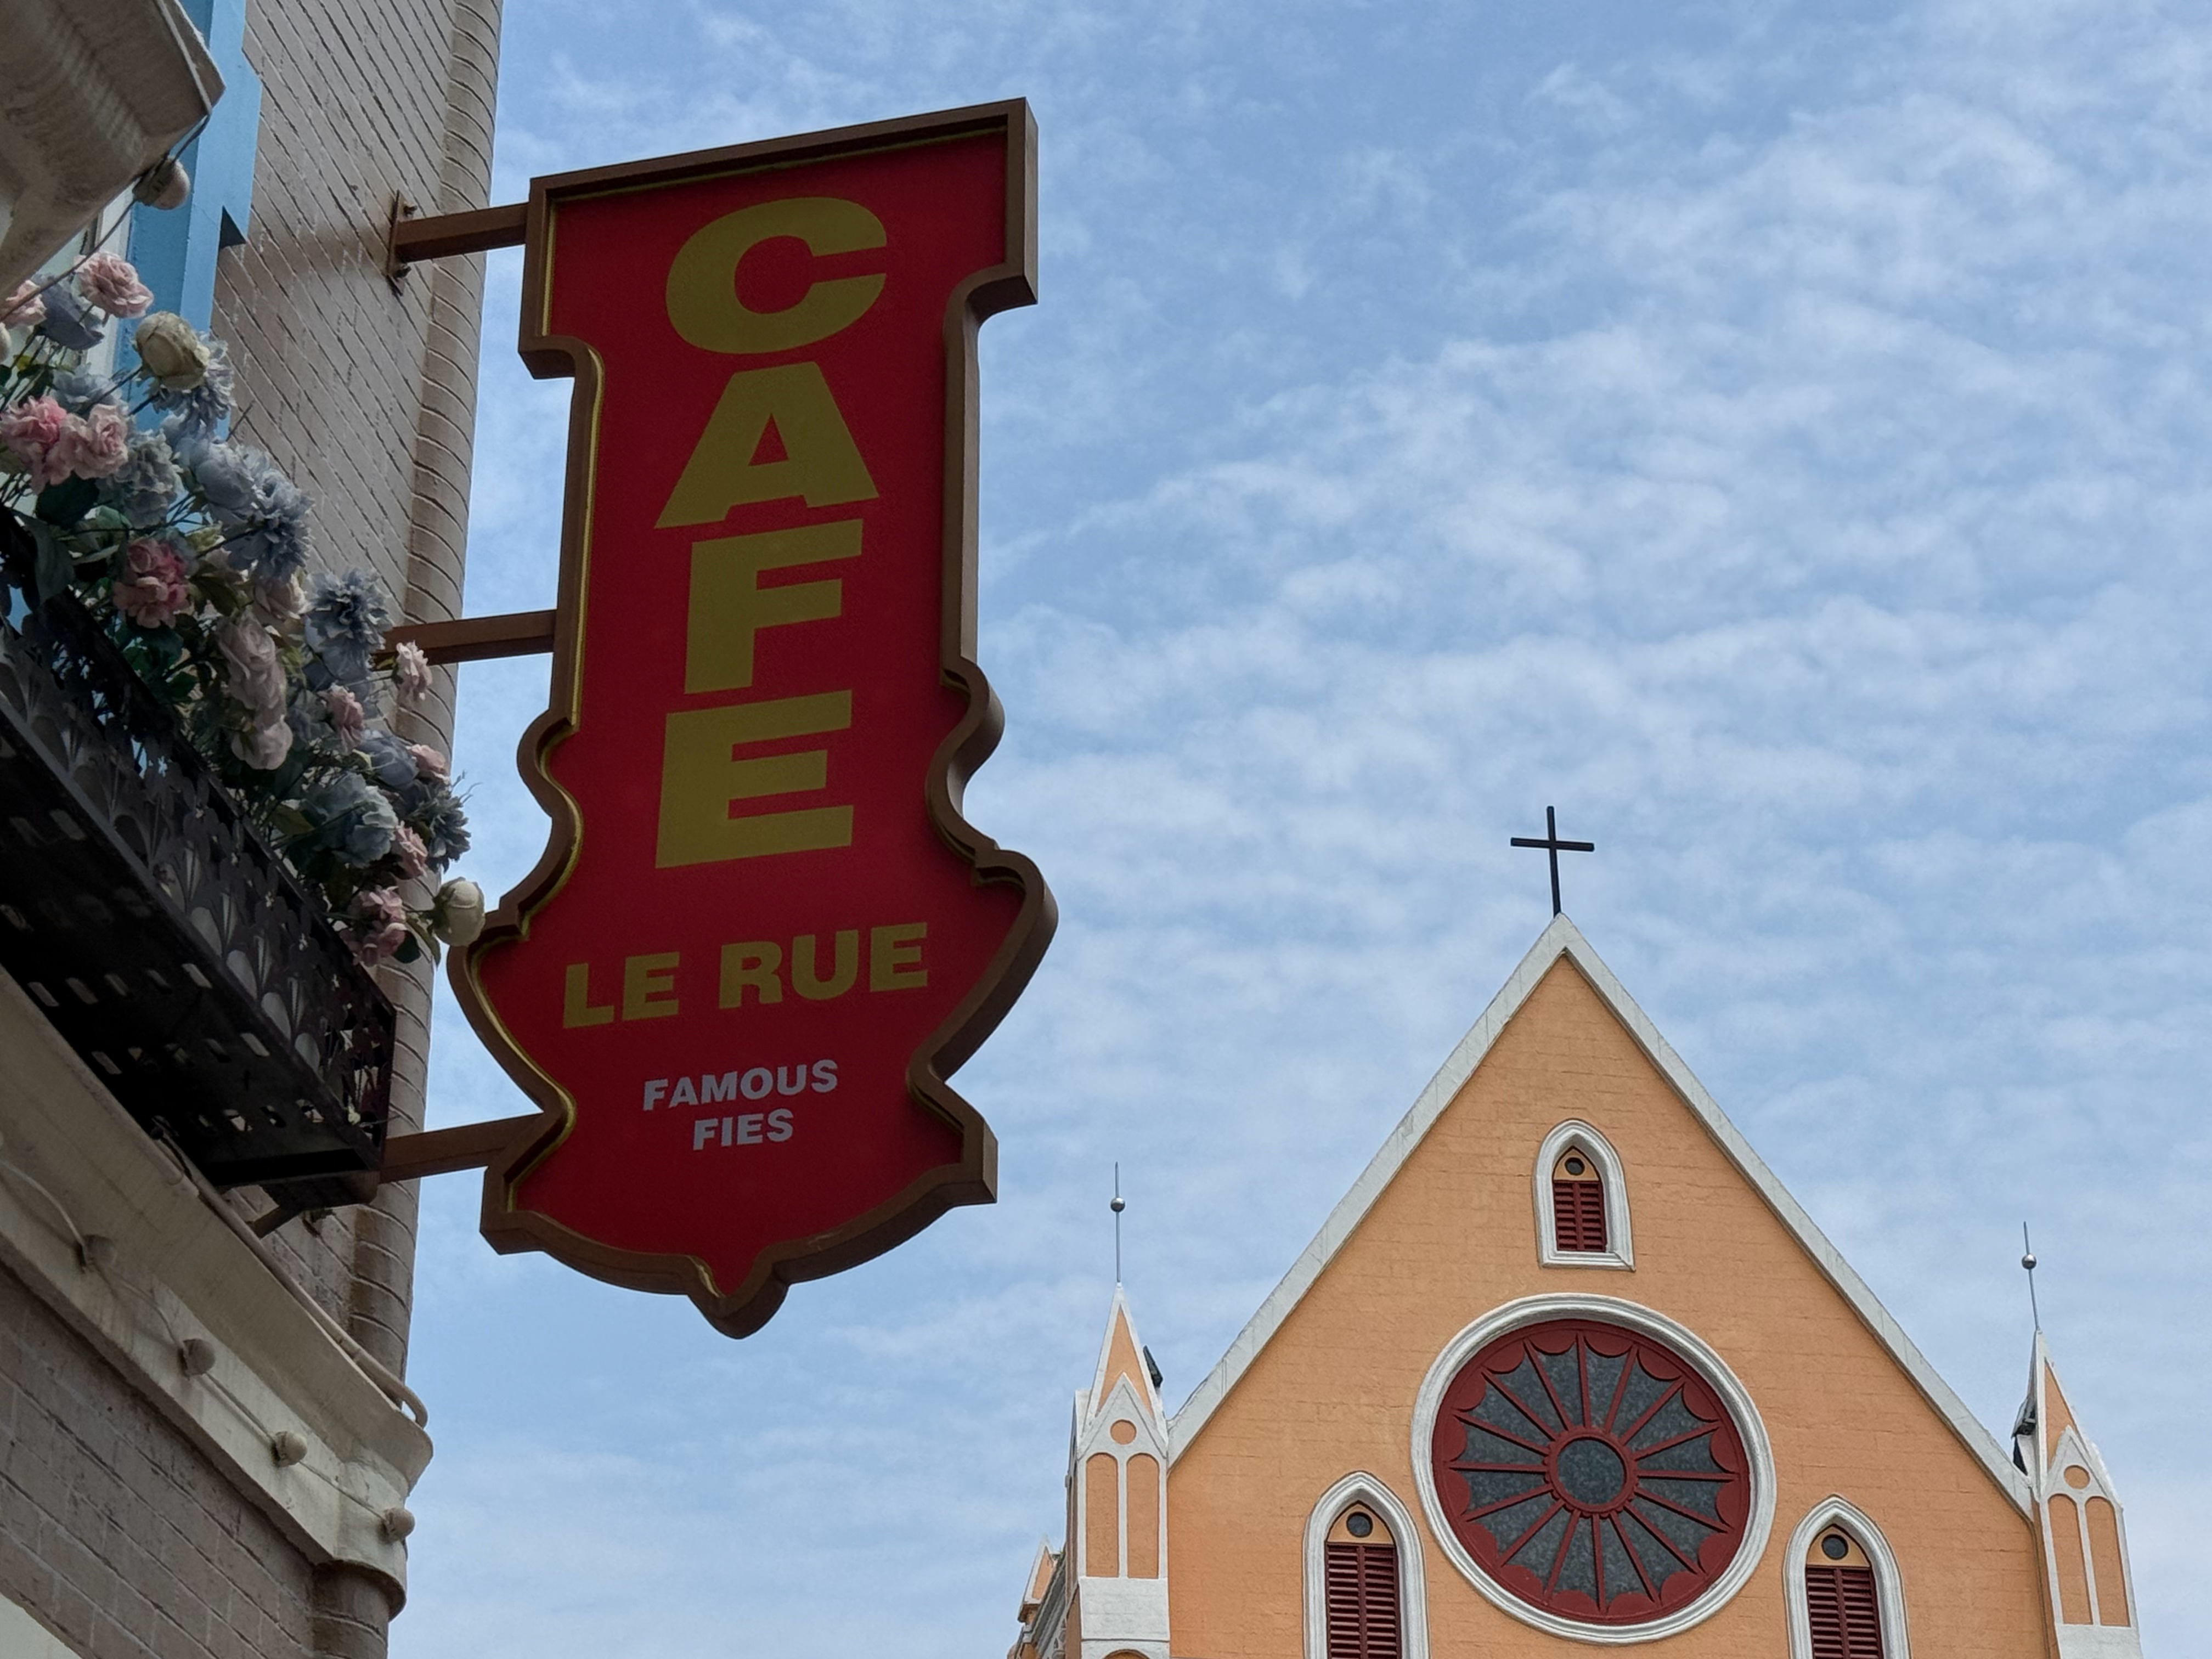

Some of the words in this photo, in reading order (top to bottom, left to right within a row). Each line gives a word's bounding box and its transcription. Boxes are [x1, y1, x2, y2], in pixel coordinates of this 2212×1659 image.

[654, 197, 887, 868] CAFE
[563, 951, 680, 1028] LE
[719, 922, 928, 1009] RUE
[643, 1059, 838, 1111] FAMOUS
[693, 1108, 794, 1150] FIES
